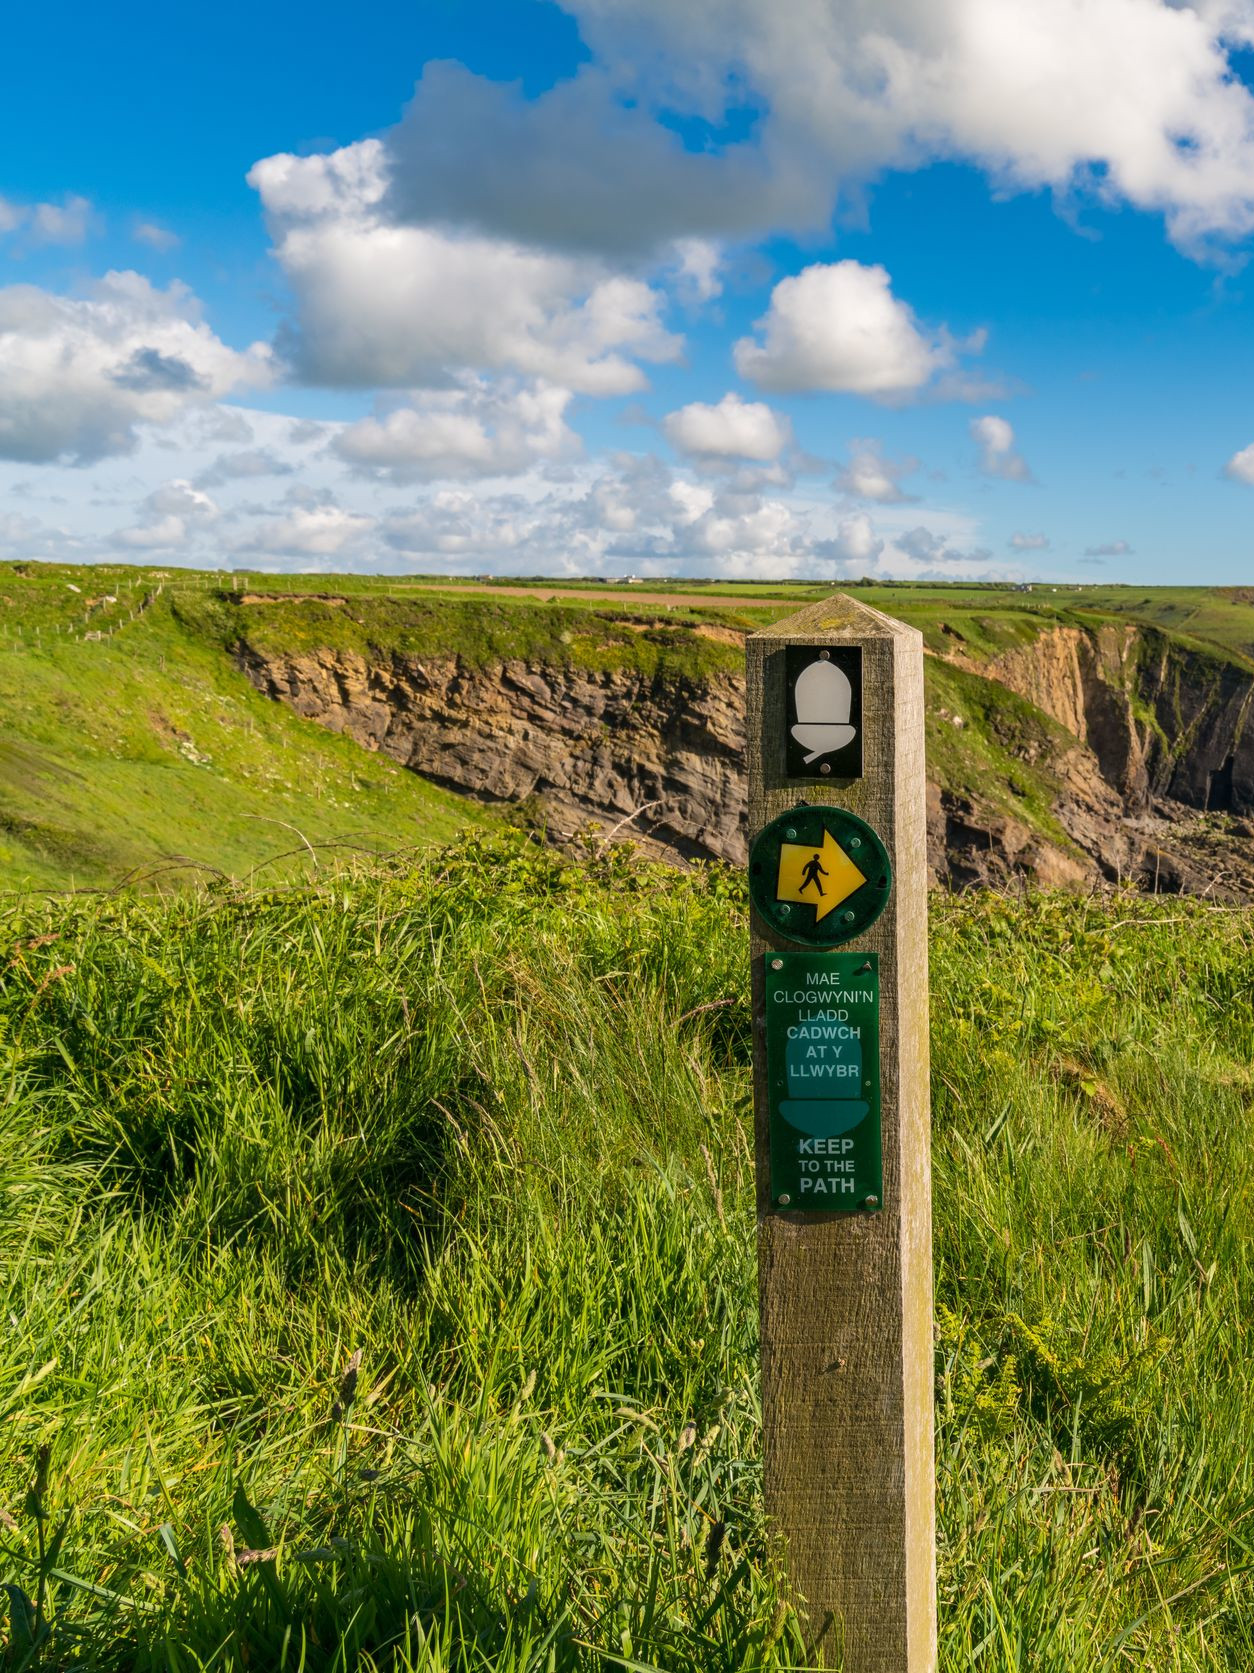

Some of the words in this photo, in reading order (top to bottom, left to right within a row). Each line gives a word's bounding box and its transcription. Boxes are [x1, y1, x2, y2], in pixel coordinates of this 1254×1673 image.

[806, 973, 840, 984] MAE
[774, 991, 873, 1003] CLOGWYNI'N
[799, 1010, 848, 1022] LLADD
[787, 1027, 861, 1039] CADWCH
[806, 1046, 827, 1058] AT
[832, 1046, 842, 1057] Y
[790, 1065, 859, 1077] LLWYBR
[799, 1139, 854, 1154] KEEP
[798, 1161, 819, 1172] TO
[824, 1161, 855, 1172] THE
[800, 1178, 855, 1193] PATH
